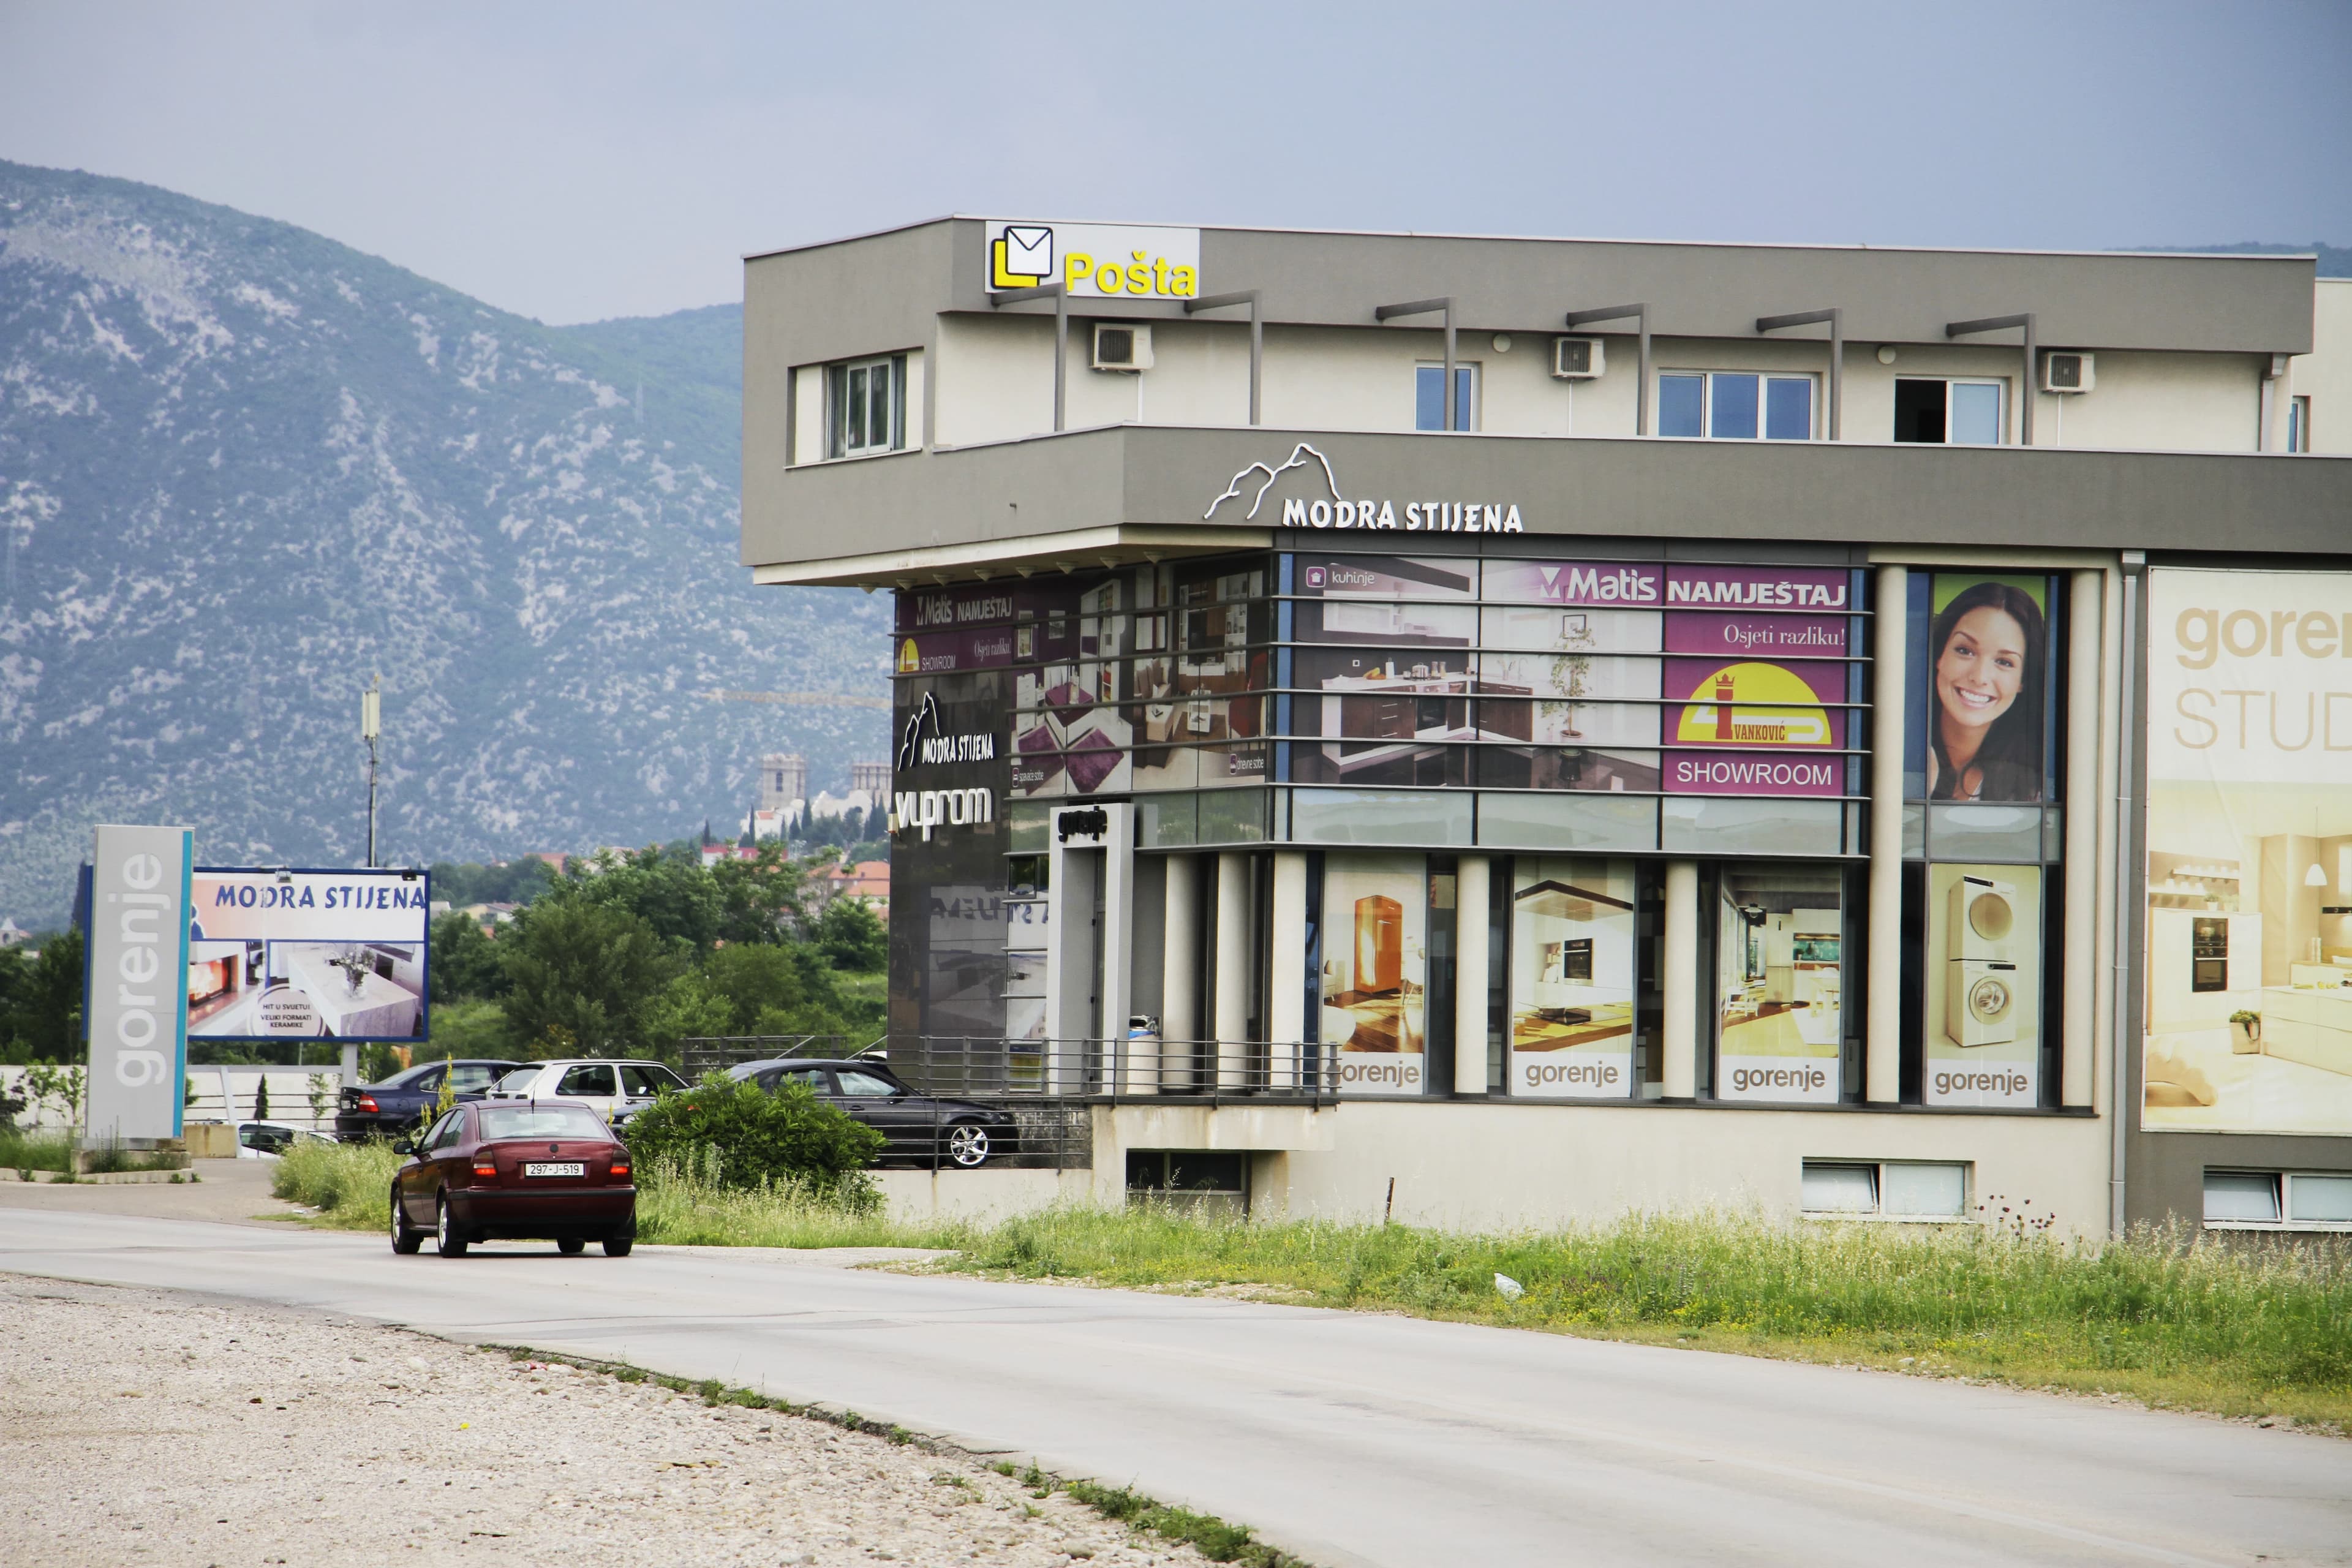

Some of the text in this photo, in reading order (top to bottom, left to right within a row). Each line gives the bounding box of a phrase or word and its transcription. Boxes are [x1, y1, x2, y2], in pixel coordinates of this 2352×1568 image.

[1065, 251, 1196, 296] Pošta
[1283, 498, 1523, 533] MODRA STIJENA
[1332, 571, 1375, 586] kuhinje
[1567, 568, 1845, 606] Matis NAMJEŠTAJ
[925, 594, 1012, 625] Matis NAMJEŠTAJ
[1724, 624, 1845, 649] Osjeti razliku!
[2175, 607, 2352, 669] gore
[922, 655, 956, 671] SHOWROOM
[922, 733, 993, 764] MODRA STIJENA
[1676, 761, 1832, 785] SHOWROOM
[895, 788, 992, 842] vuprom
[216, 885, 426, 910] MODRA STIJENA
[107, 853, 172, 1087] gorenje
[1526, 1061, 1618, 1088] gorenje
[1733, 1065, 1826, 1091] gorenje
[1935, 1069, 2028, 1096] gorenje
[530, 1164, 579, 1174] 297-J-519
